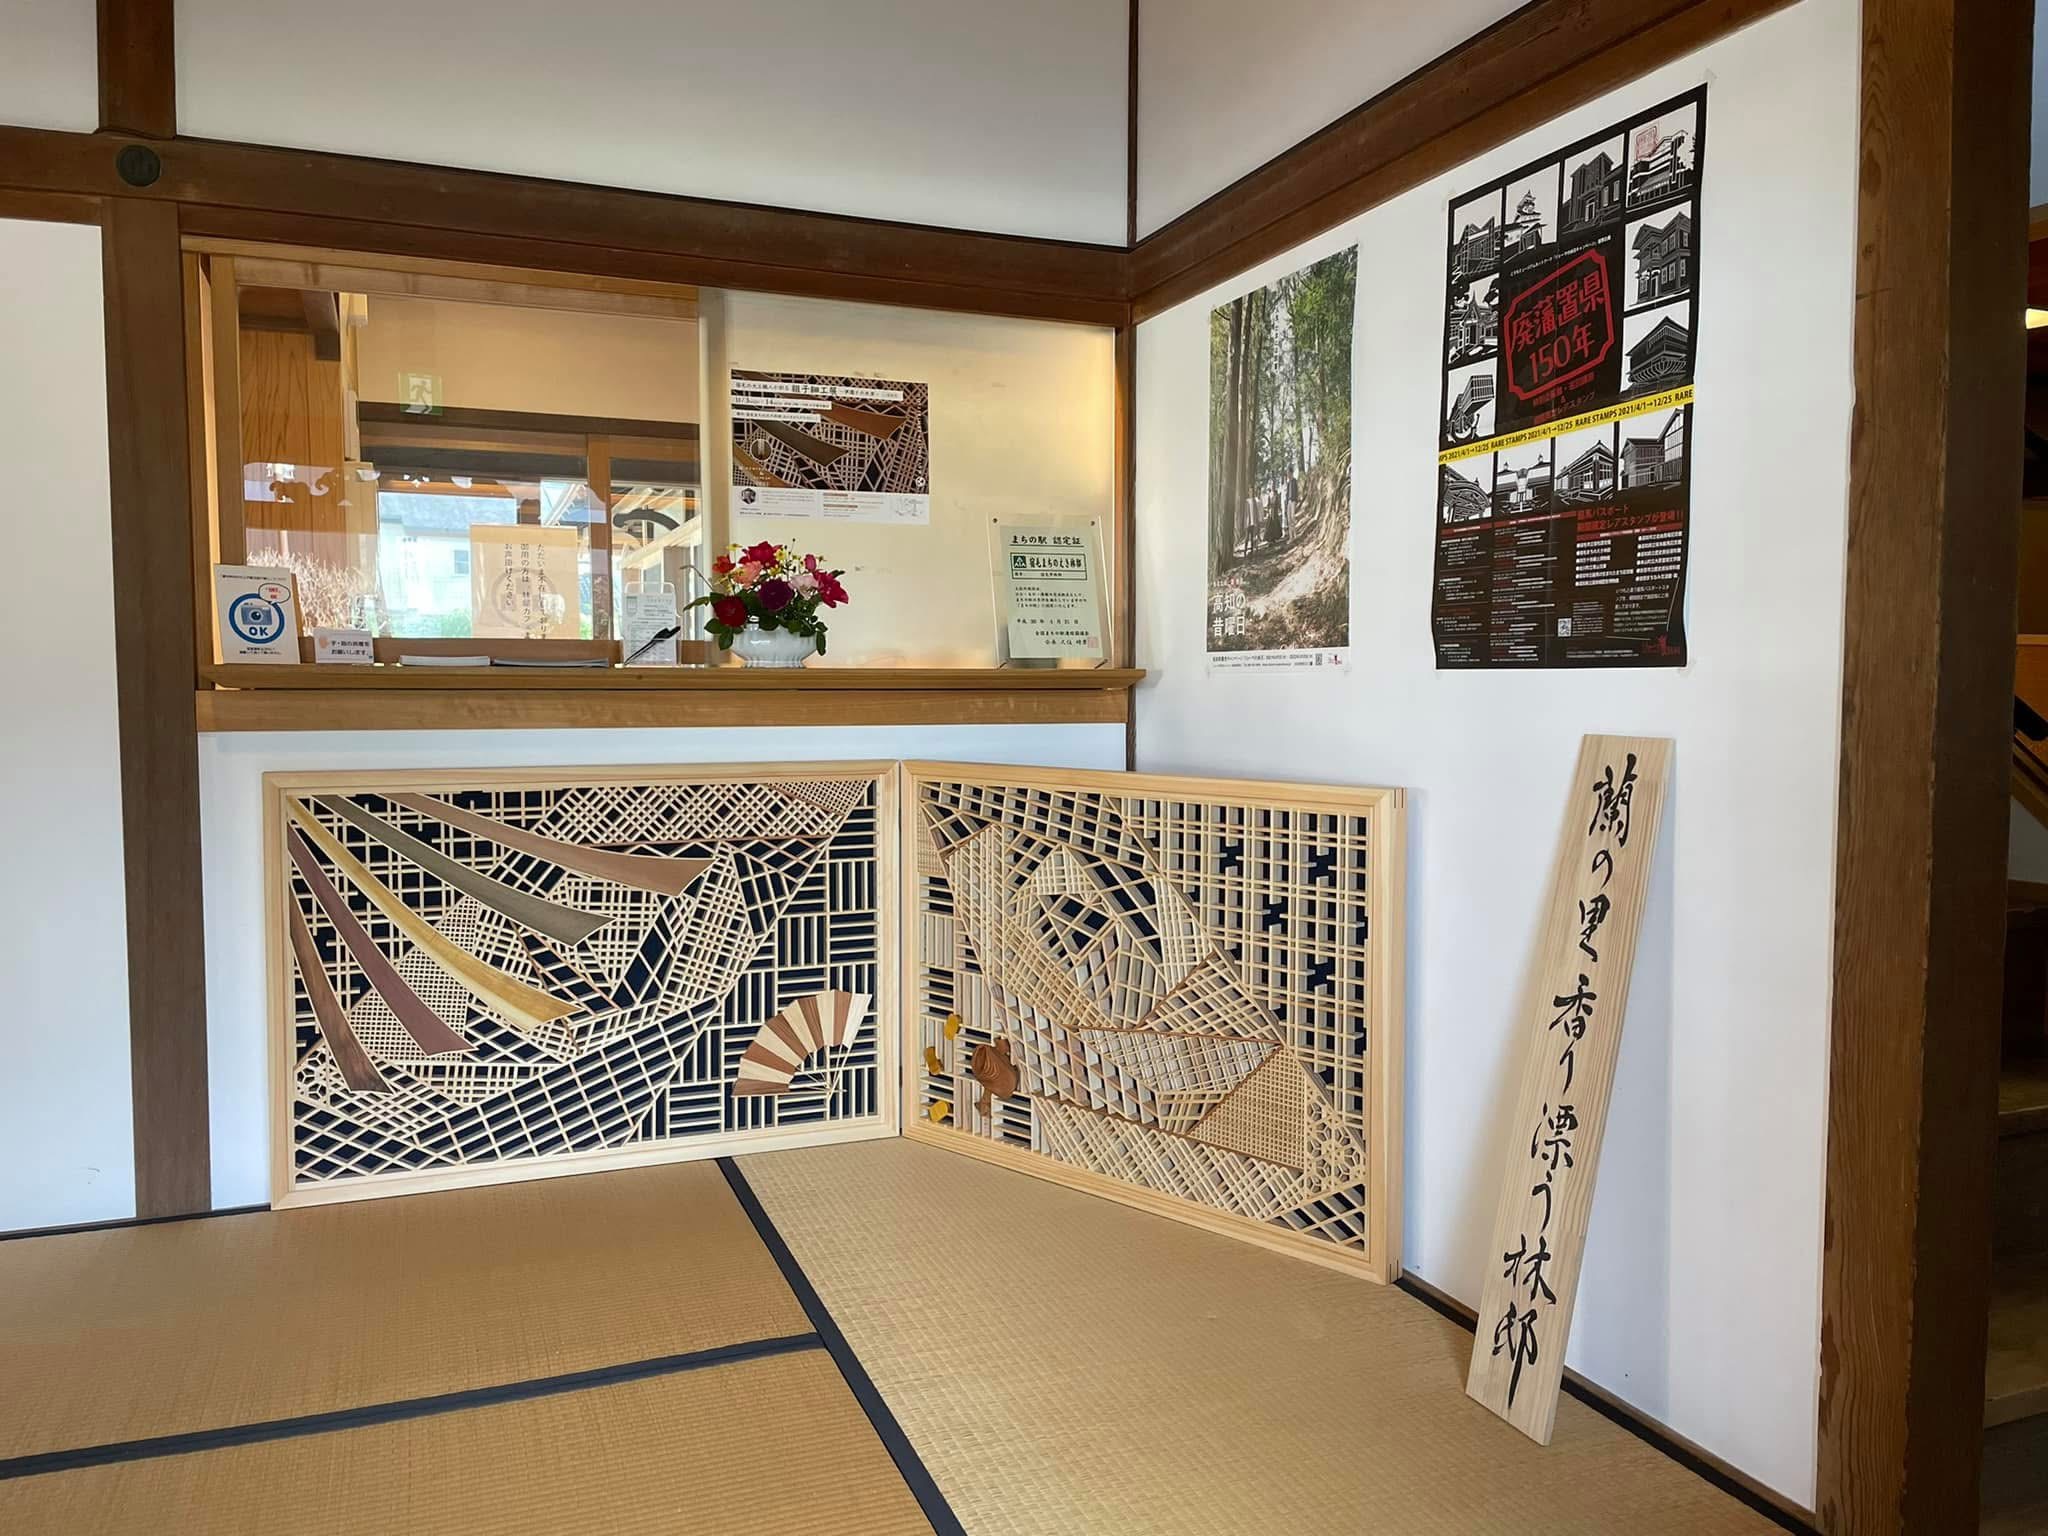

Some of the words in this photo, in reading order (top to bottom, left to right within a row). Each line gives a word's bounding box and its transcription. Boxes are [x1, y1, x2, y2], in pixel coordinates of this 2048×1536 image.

[1511, 271, 1606, 352] 廃藩置県
[1529, 322, 1595, 384] 150年
[1505, 433, 1527, 446] STAMPS
[1575, 416, 1592, 427] RARE
[1592, 410, 1617, 423] STAMPS
[1675, 389, 1693, 400] RARE
[1012, 535, 1047, 544] まちの駅
[1212, 592, 1246, 614] 高知の
[248, 626, 269, 637] OK
